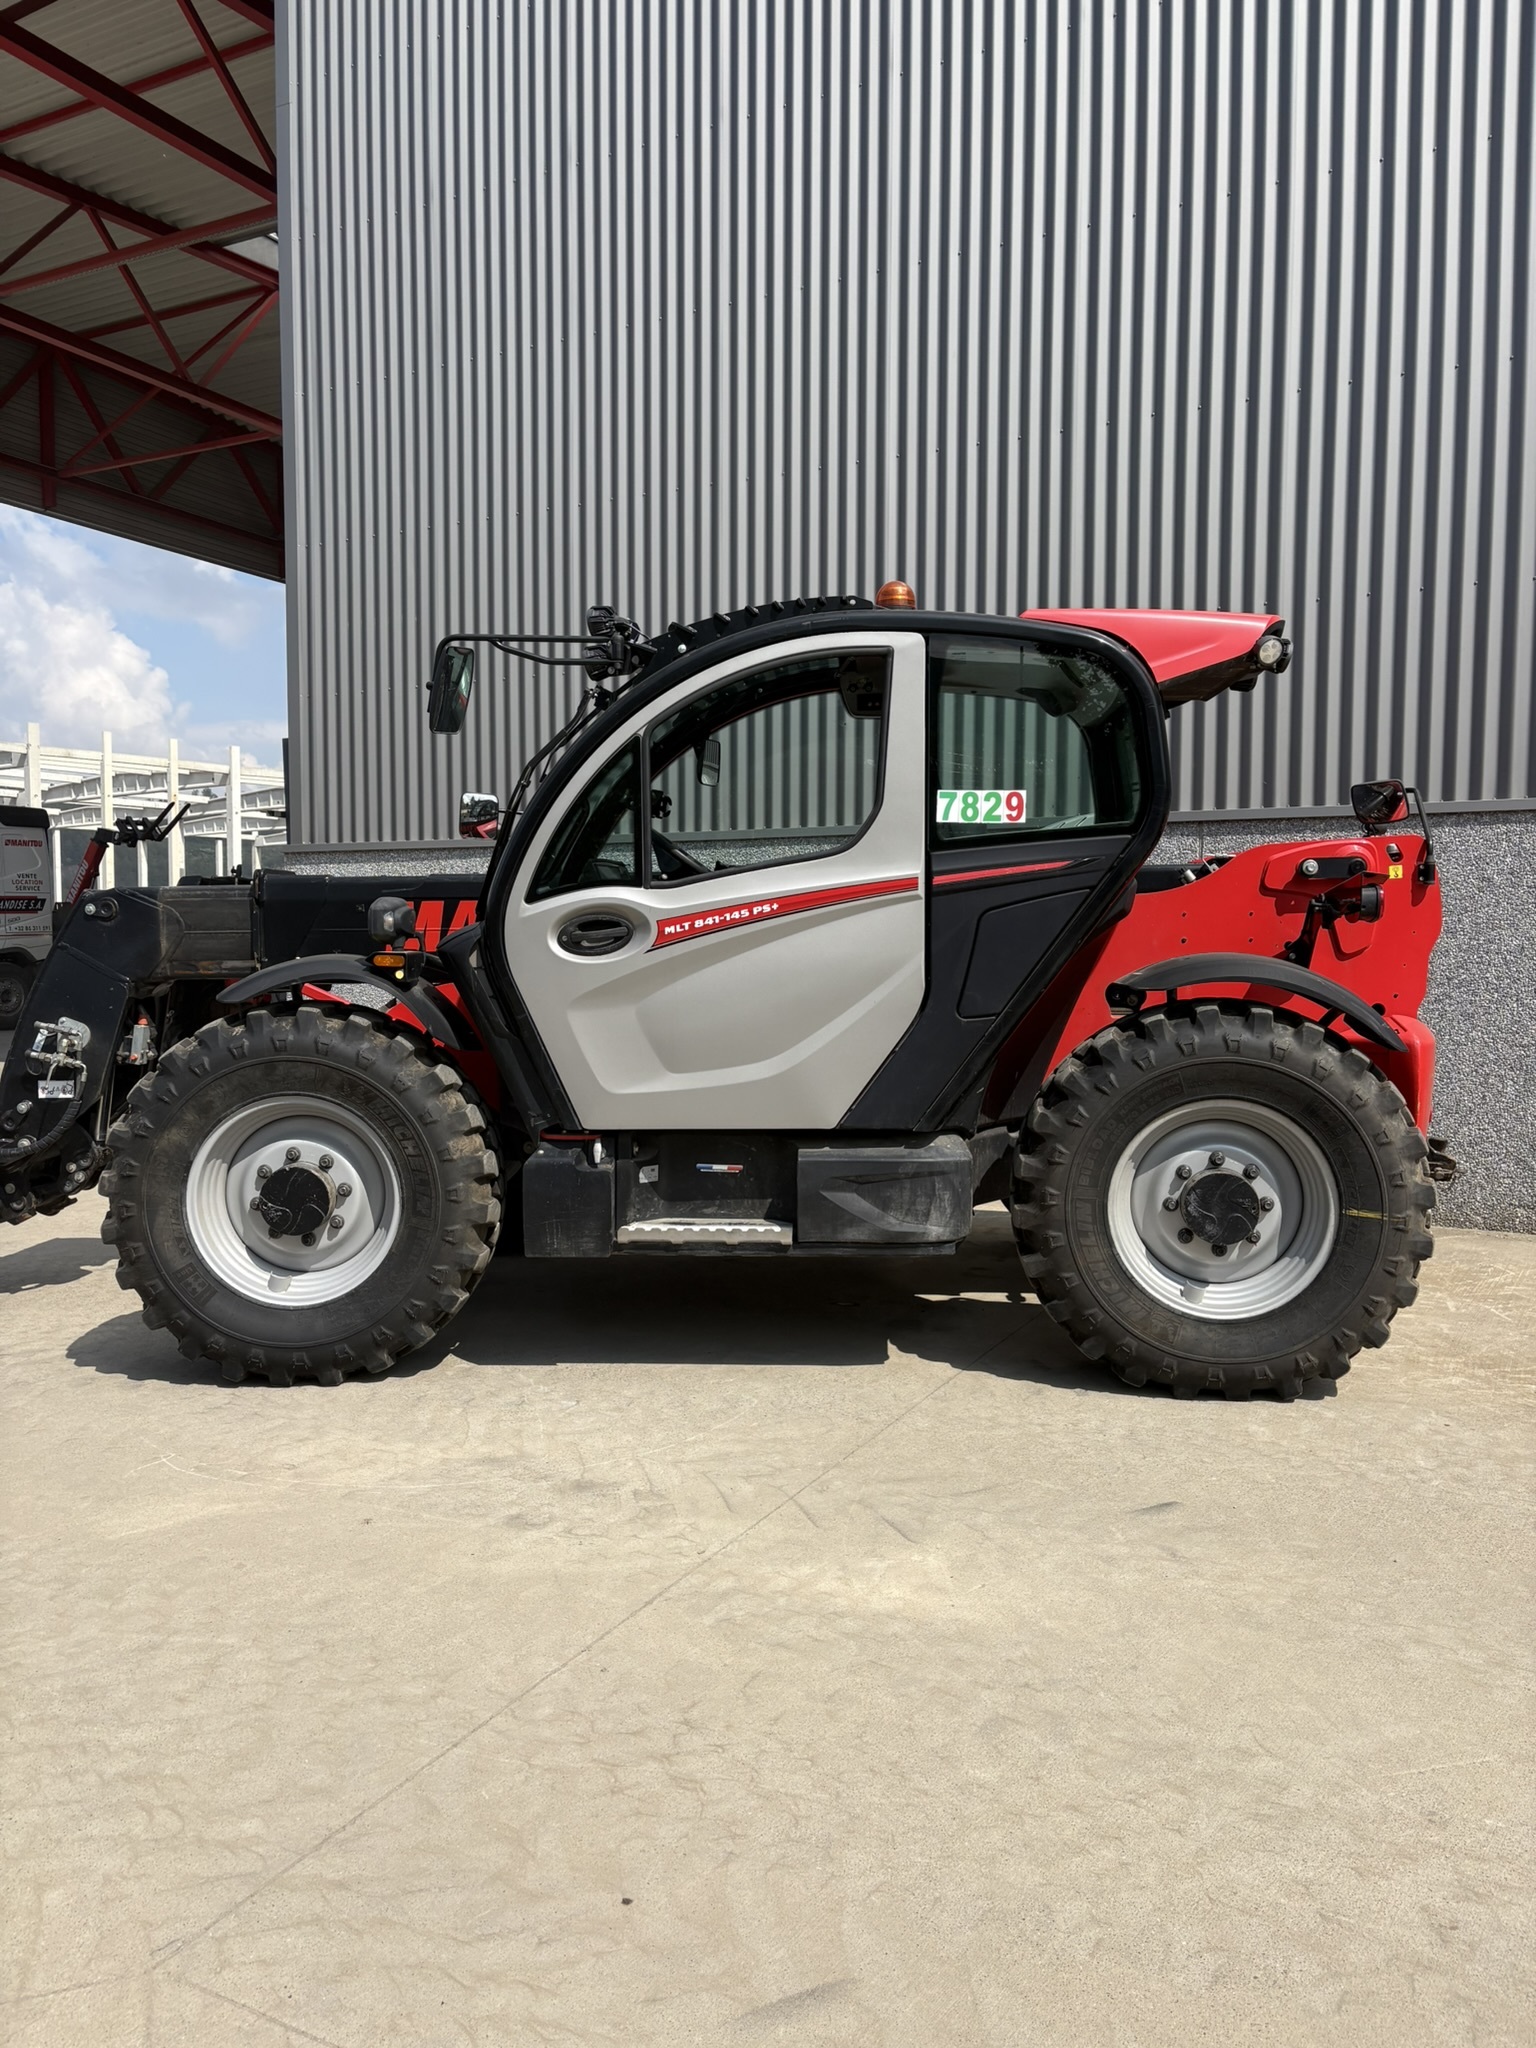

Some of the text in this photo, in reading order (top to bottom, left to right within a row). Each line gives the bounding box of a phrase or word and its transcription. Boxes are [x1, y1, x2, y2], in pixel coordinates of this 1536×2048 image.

[939, 791, 1024, 822] 7829
[11, 839, 43, 847] MANITOU
[66, 860, 89, 904] MANITOU
[29, 900, 43, 910] S.A.
[664, 903, 779, 935] MLT 841-145 PS+
[1075, 1201, 1150, 1325] MICHELIN
